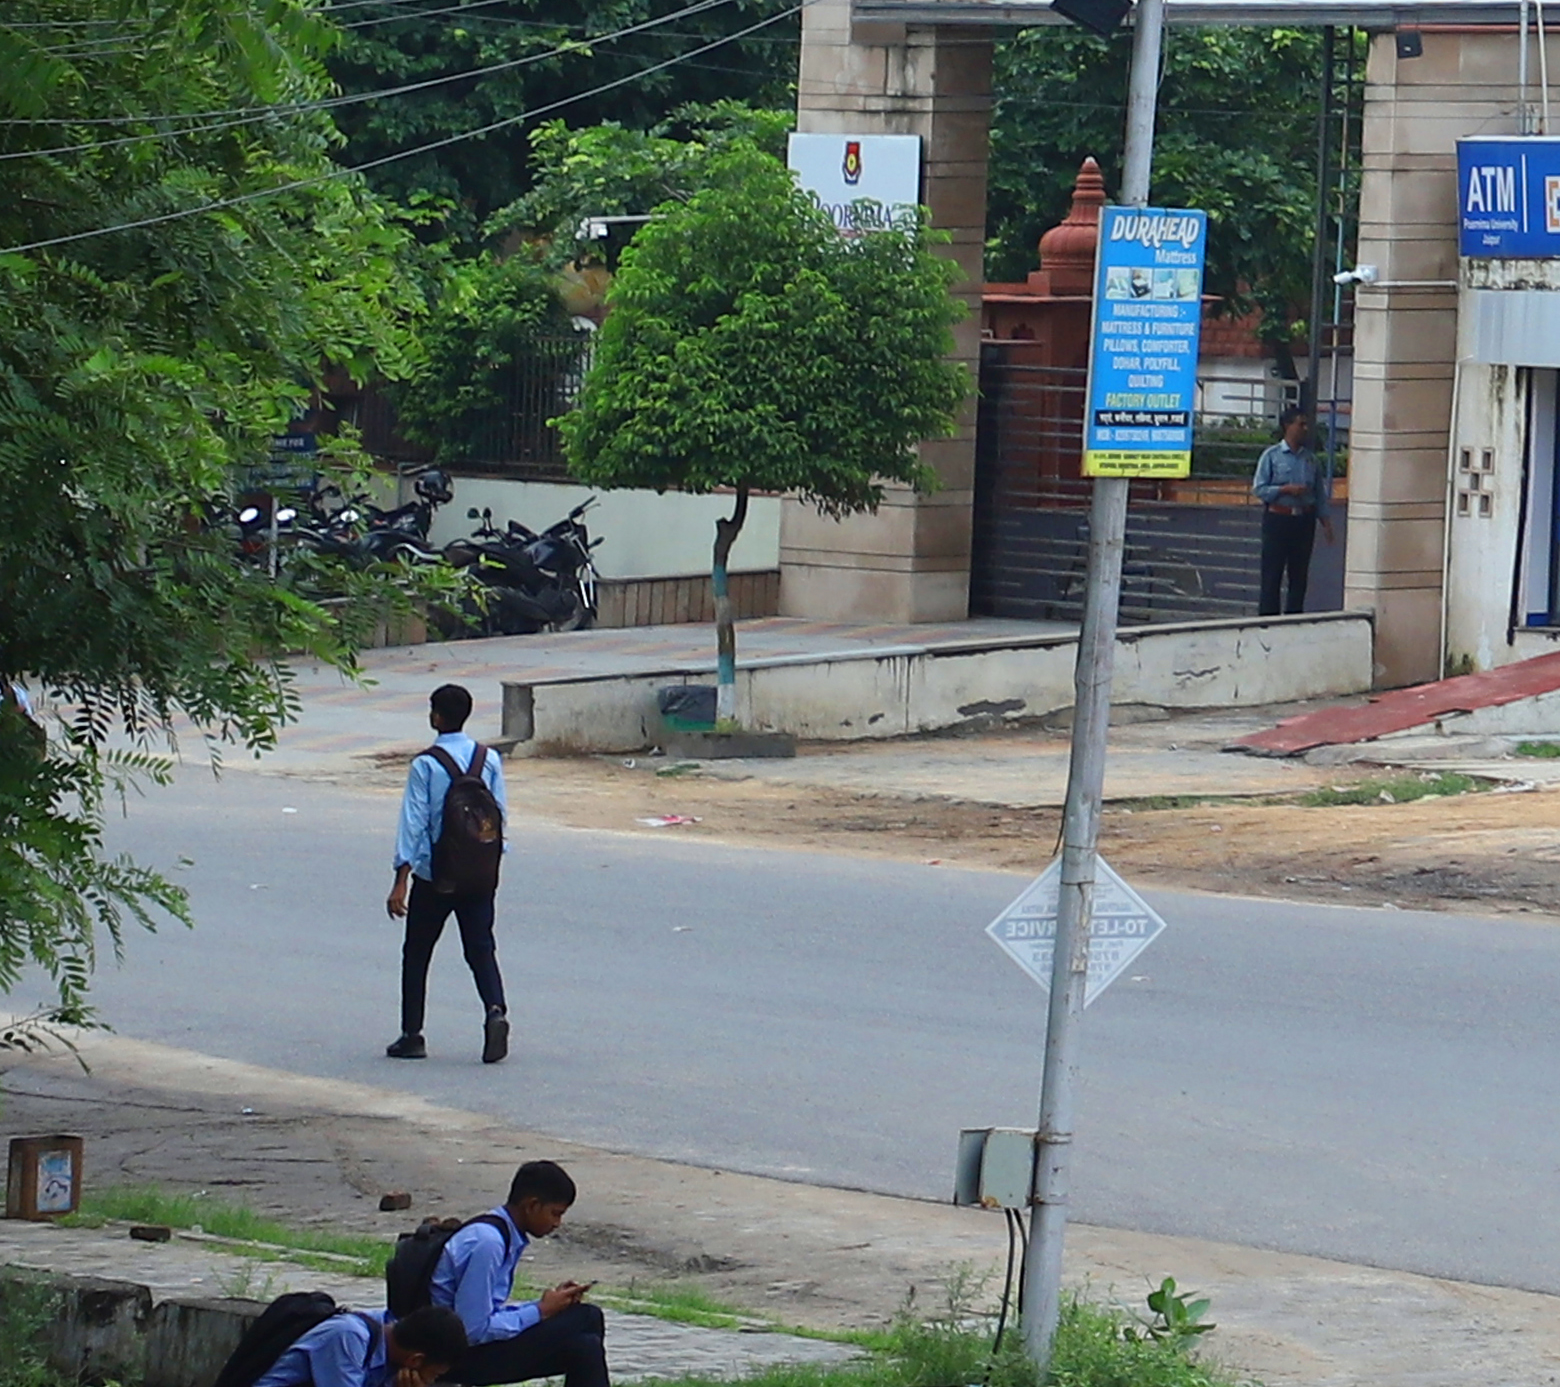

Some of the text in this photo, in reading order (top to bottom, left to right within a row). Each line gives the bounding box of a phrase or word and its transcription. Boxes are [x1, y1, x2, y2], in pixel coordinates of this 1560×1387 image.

[1467, 166, 1516, 212] ATM
[1110, 215, 1200, 249] DURAHEAD
[1155, 248, 1197, 264] Mattress
[1101, 321, 1142, 335] MATTRESS
[1152, 322, 1195, 336] FURNITURE
[1106, 392, 1182, 408] FACTORY OUTLET
